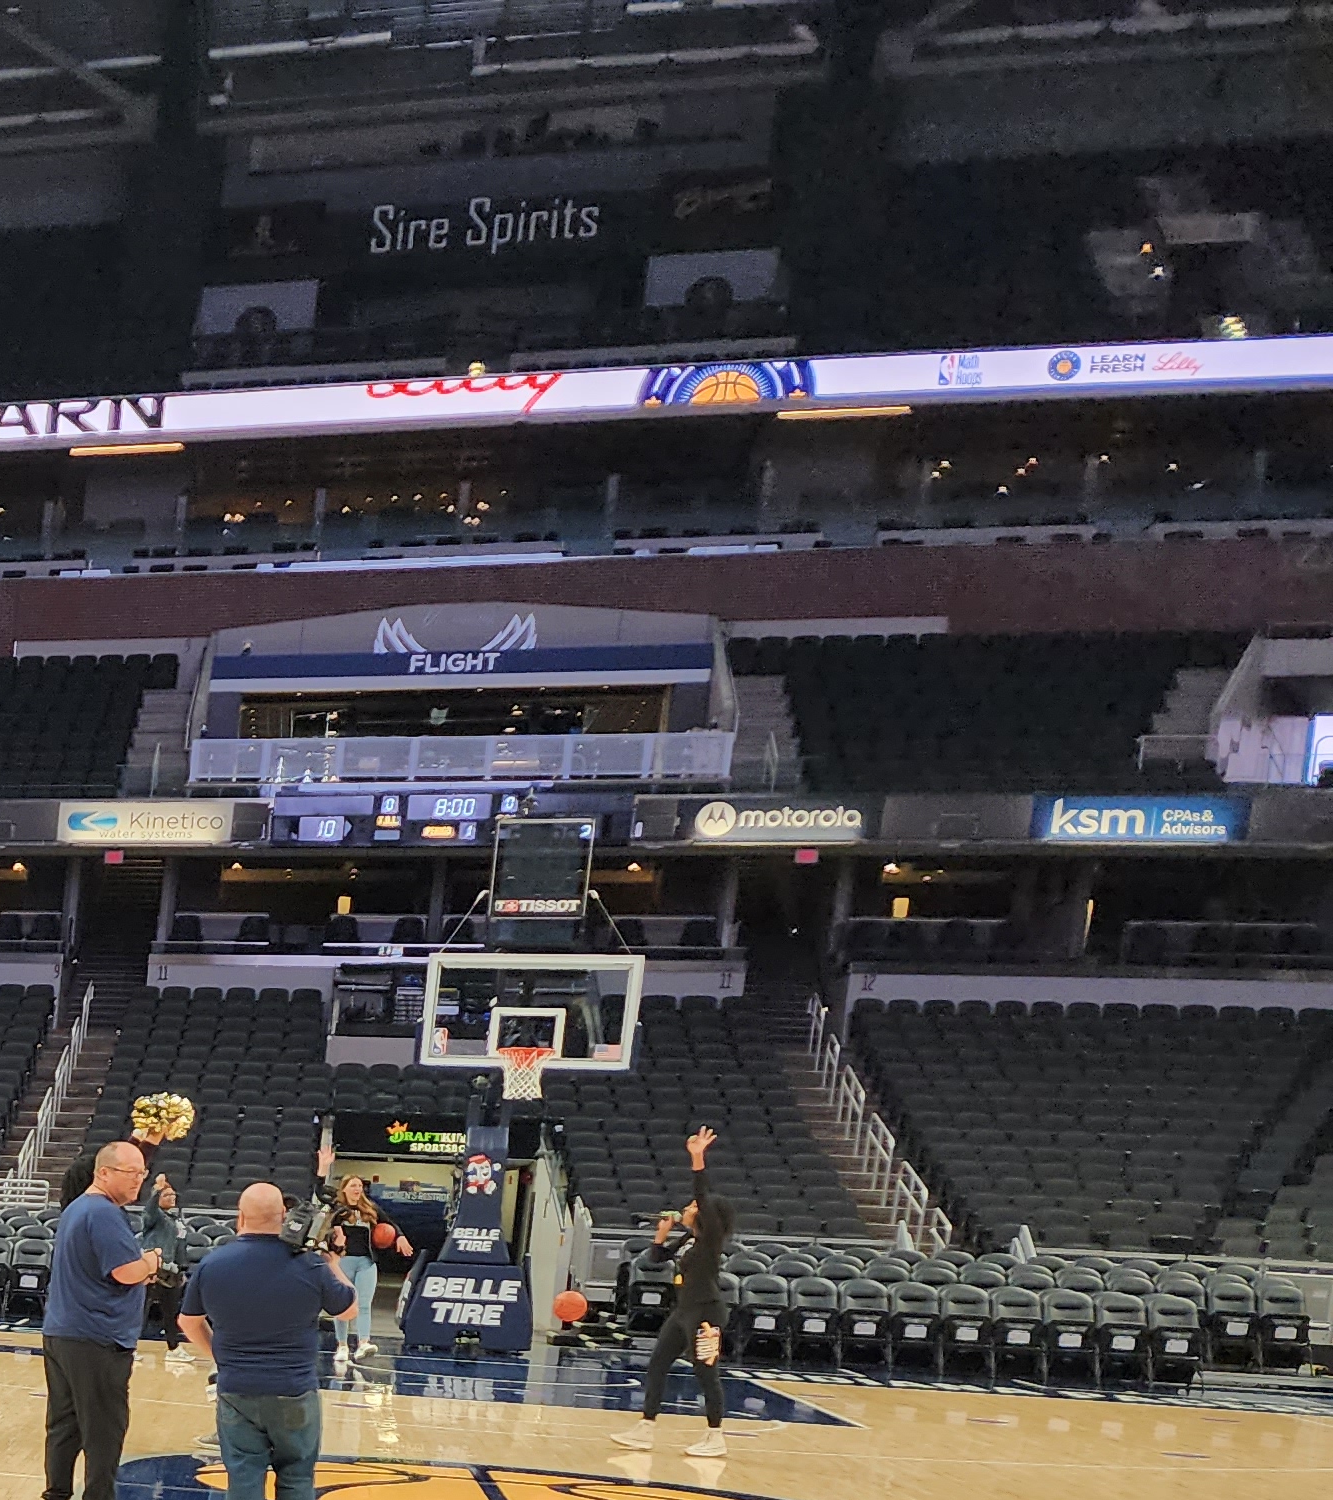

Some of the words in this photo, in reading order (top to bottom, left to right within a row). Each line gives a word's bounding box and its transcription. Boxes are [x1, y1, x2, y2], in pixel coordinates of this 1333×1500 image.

[370, 203, 450, 254] Sire
[465, 197, 600, 255] Spirits
[1090, 353, 1146, 364] LEARN
[1089, 362, 1145, 374] FRESH
[409, 652, 501, 673] FLIGHT
[435, 797, 476, 817] 8:00
[128, 811, 224, 831] Kinetico
[738, 805, 863, 830] motorola
[1049, 797, 1146, 836] ksm
[98, 831, 134, 839] water
[136, 829, 194, 841] systems
[317, 819, 337, 838] 10
[1160, 821, 1228, 837] Advisors
[518, 899, 582, 913] TISSOT
[157, 964, 168, 981] 11
[719, 972, 732, 989] 11
[388, 1131, 467, 1144] DRAFTKIN
[409, 1142, 466, 1153] SPORTSBO
[452, 1227, 501, 1241] BELLE
[456, 1239, 493, 1252] TIRE
[421, 1276, 522, 1302] BELLE
[431, 1302, 505, 1326] TIRE
